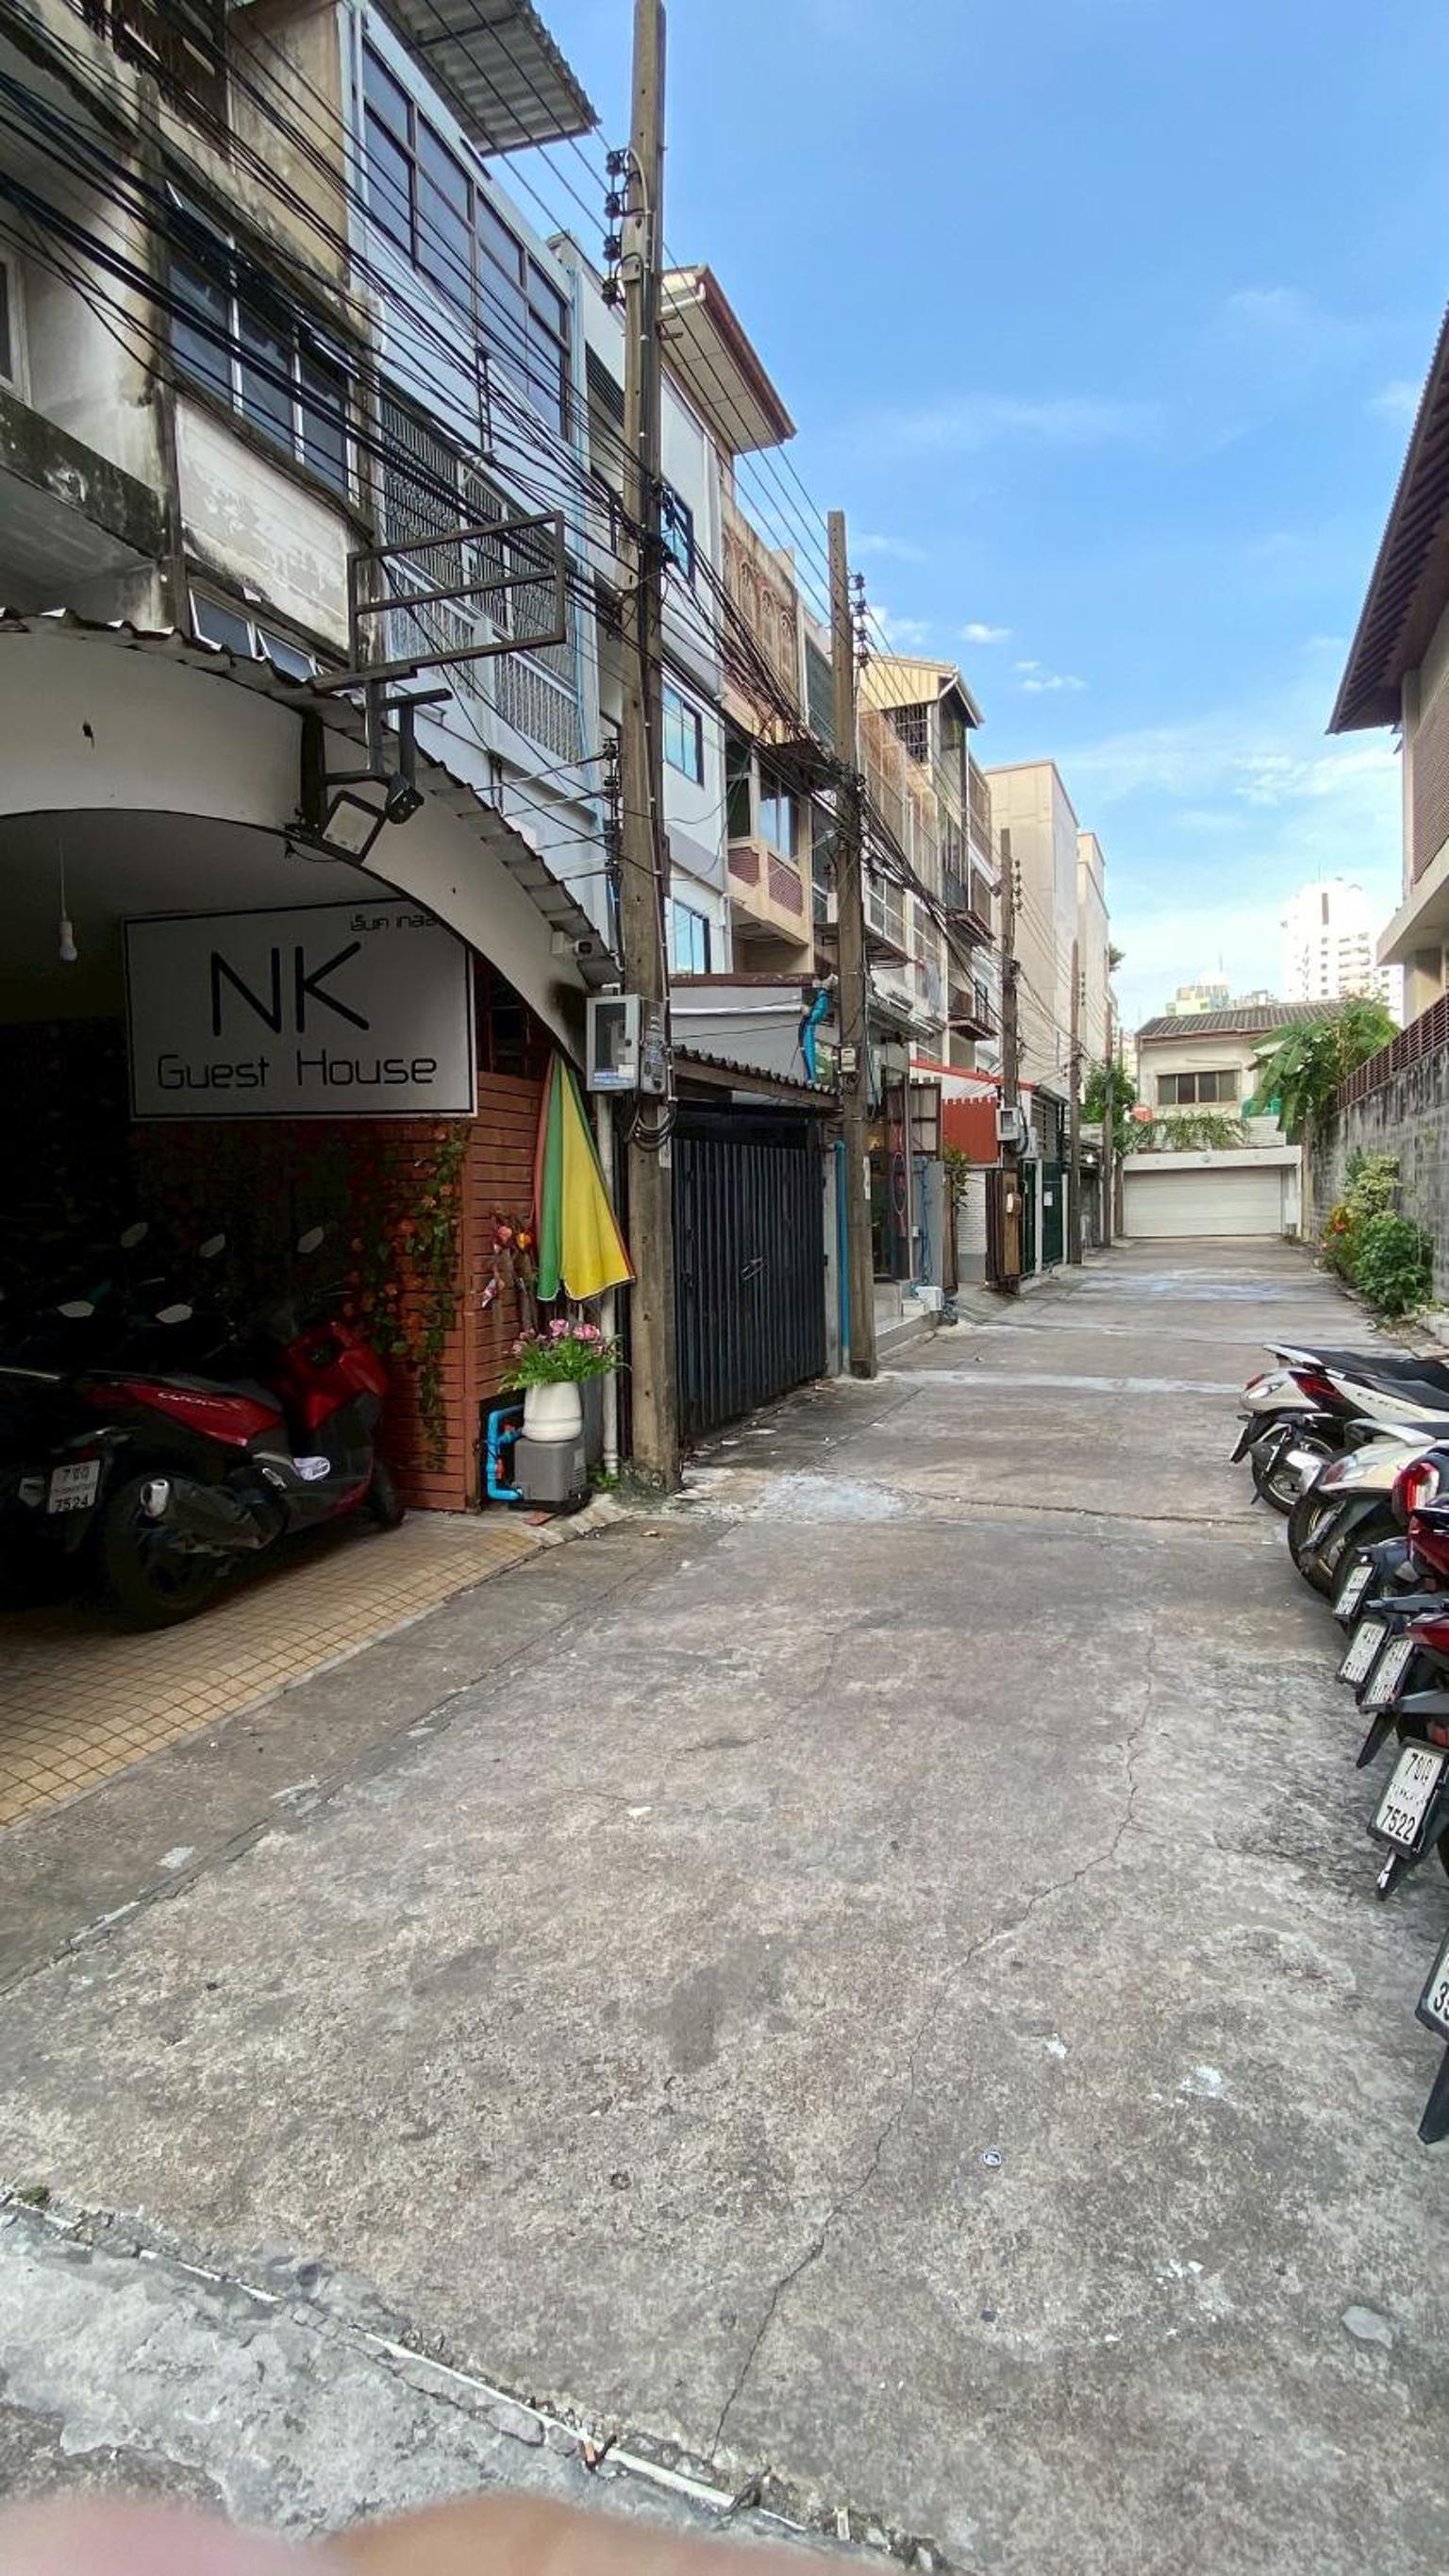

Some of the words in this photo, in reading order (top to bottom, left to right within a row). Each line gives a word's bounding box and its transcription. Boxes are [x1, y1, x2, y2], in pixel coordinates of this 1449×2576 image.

[210, 941, 370, 1037] NK
[157, 1054, 271, 1090] Guest
[296, 1048, 438, 1087] House
[1379, 1804, 1416, 1841] 7522
